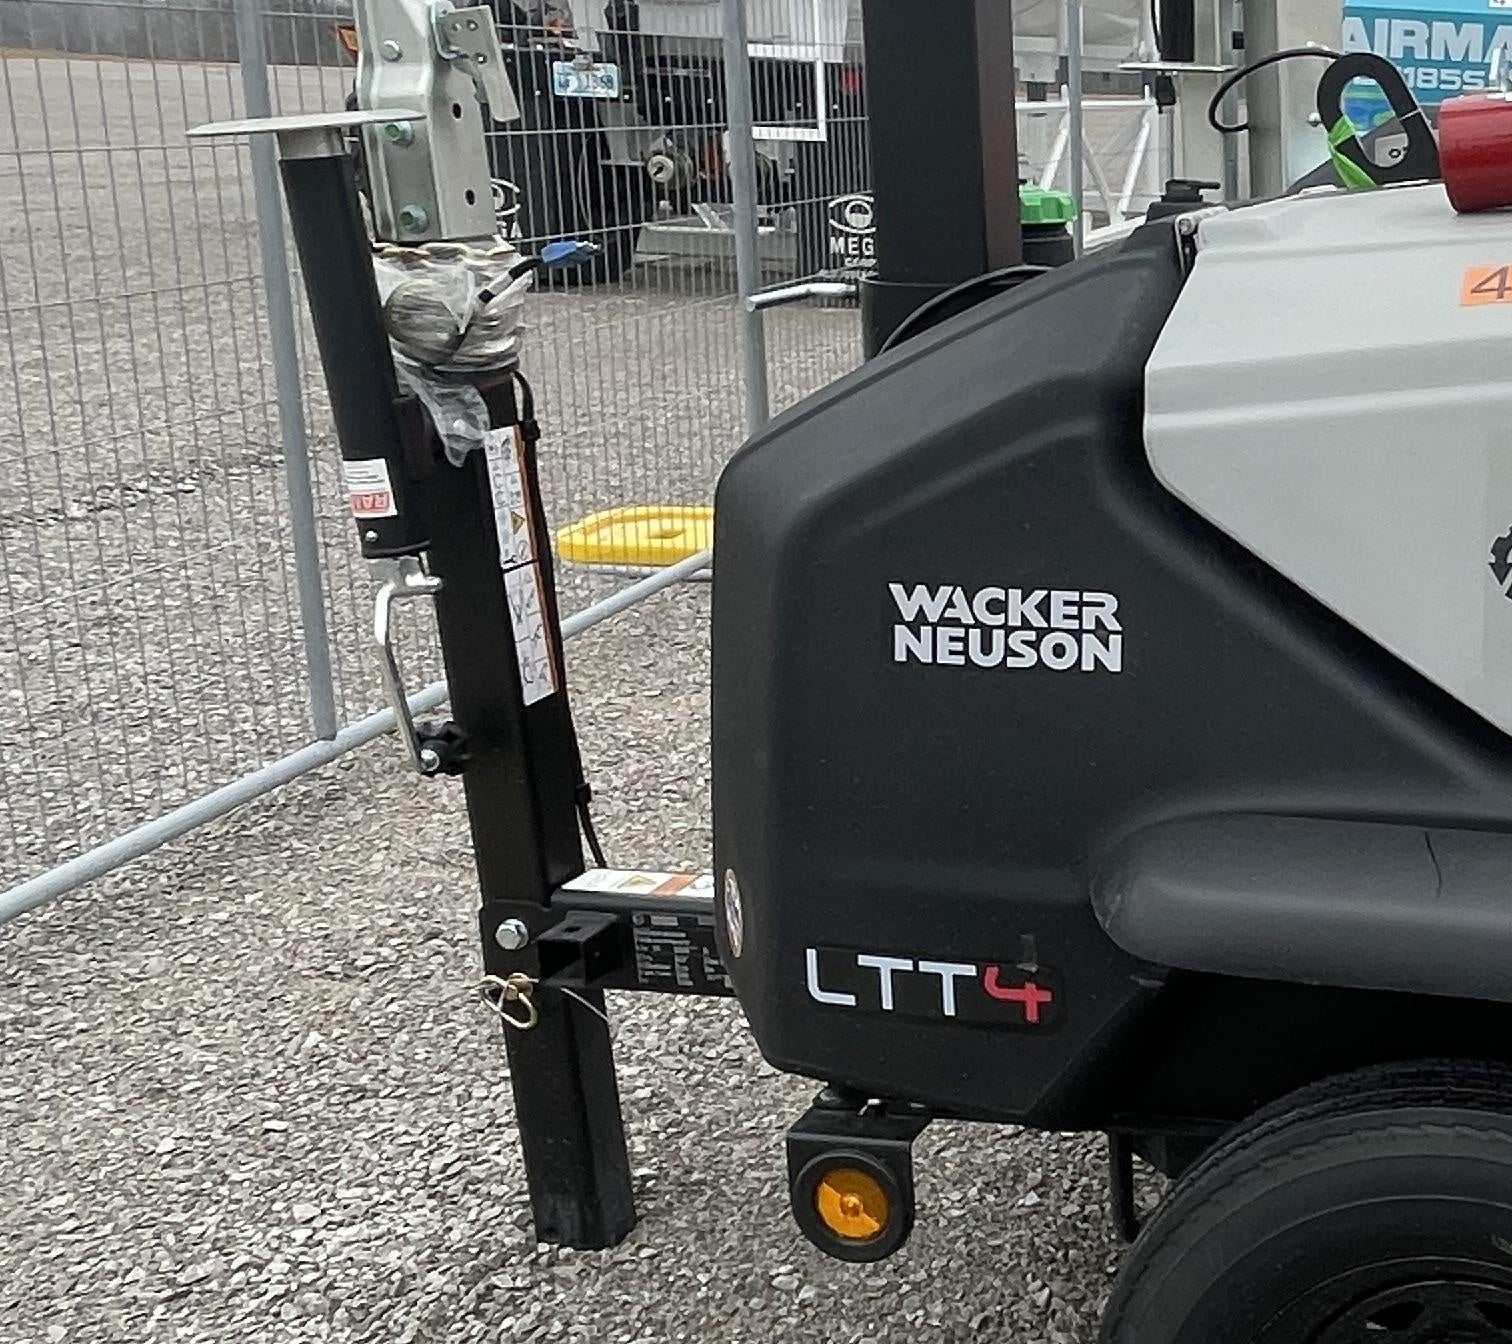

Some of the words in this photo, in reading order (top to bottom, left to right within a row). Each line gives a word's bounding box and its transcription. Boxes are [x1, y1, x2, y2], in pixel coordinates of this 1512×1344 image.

[830, 237, 876, 256] MEG
[888, 583, 1124, 631] WACKER
[894, 624, 1122, 672] NEUSON
[806, 948, 1052, 1024] LTT4
